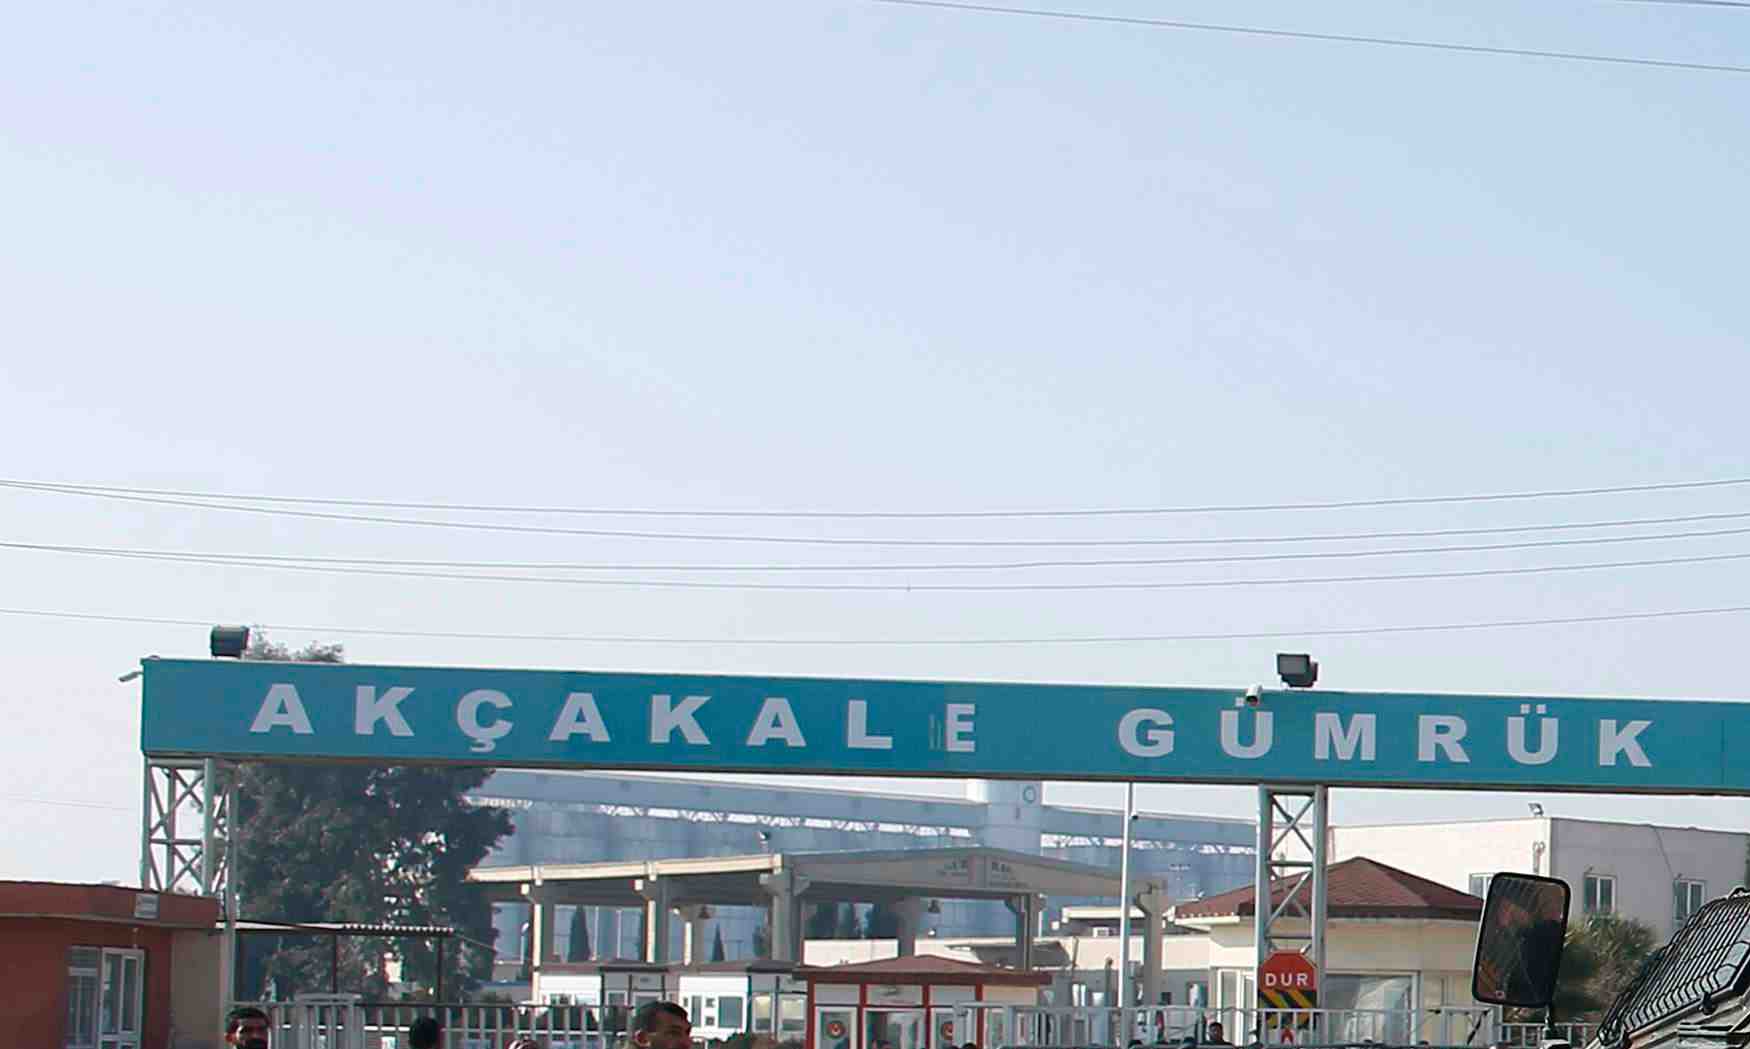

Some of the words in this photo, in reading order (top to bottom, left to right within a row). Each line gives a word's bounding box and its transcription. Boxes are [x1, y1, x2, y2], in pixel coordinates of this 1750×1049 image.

[250, 682, 977, 754] AKÇAKALE
[1117, 697, 1653, 768] GÜMRÜK
[1264, 972, 1309, 988] DUR
